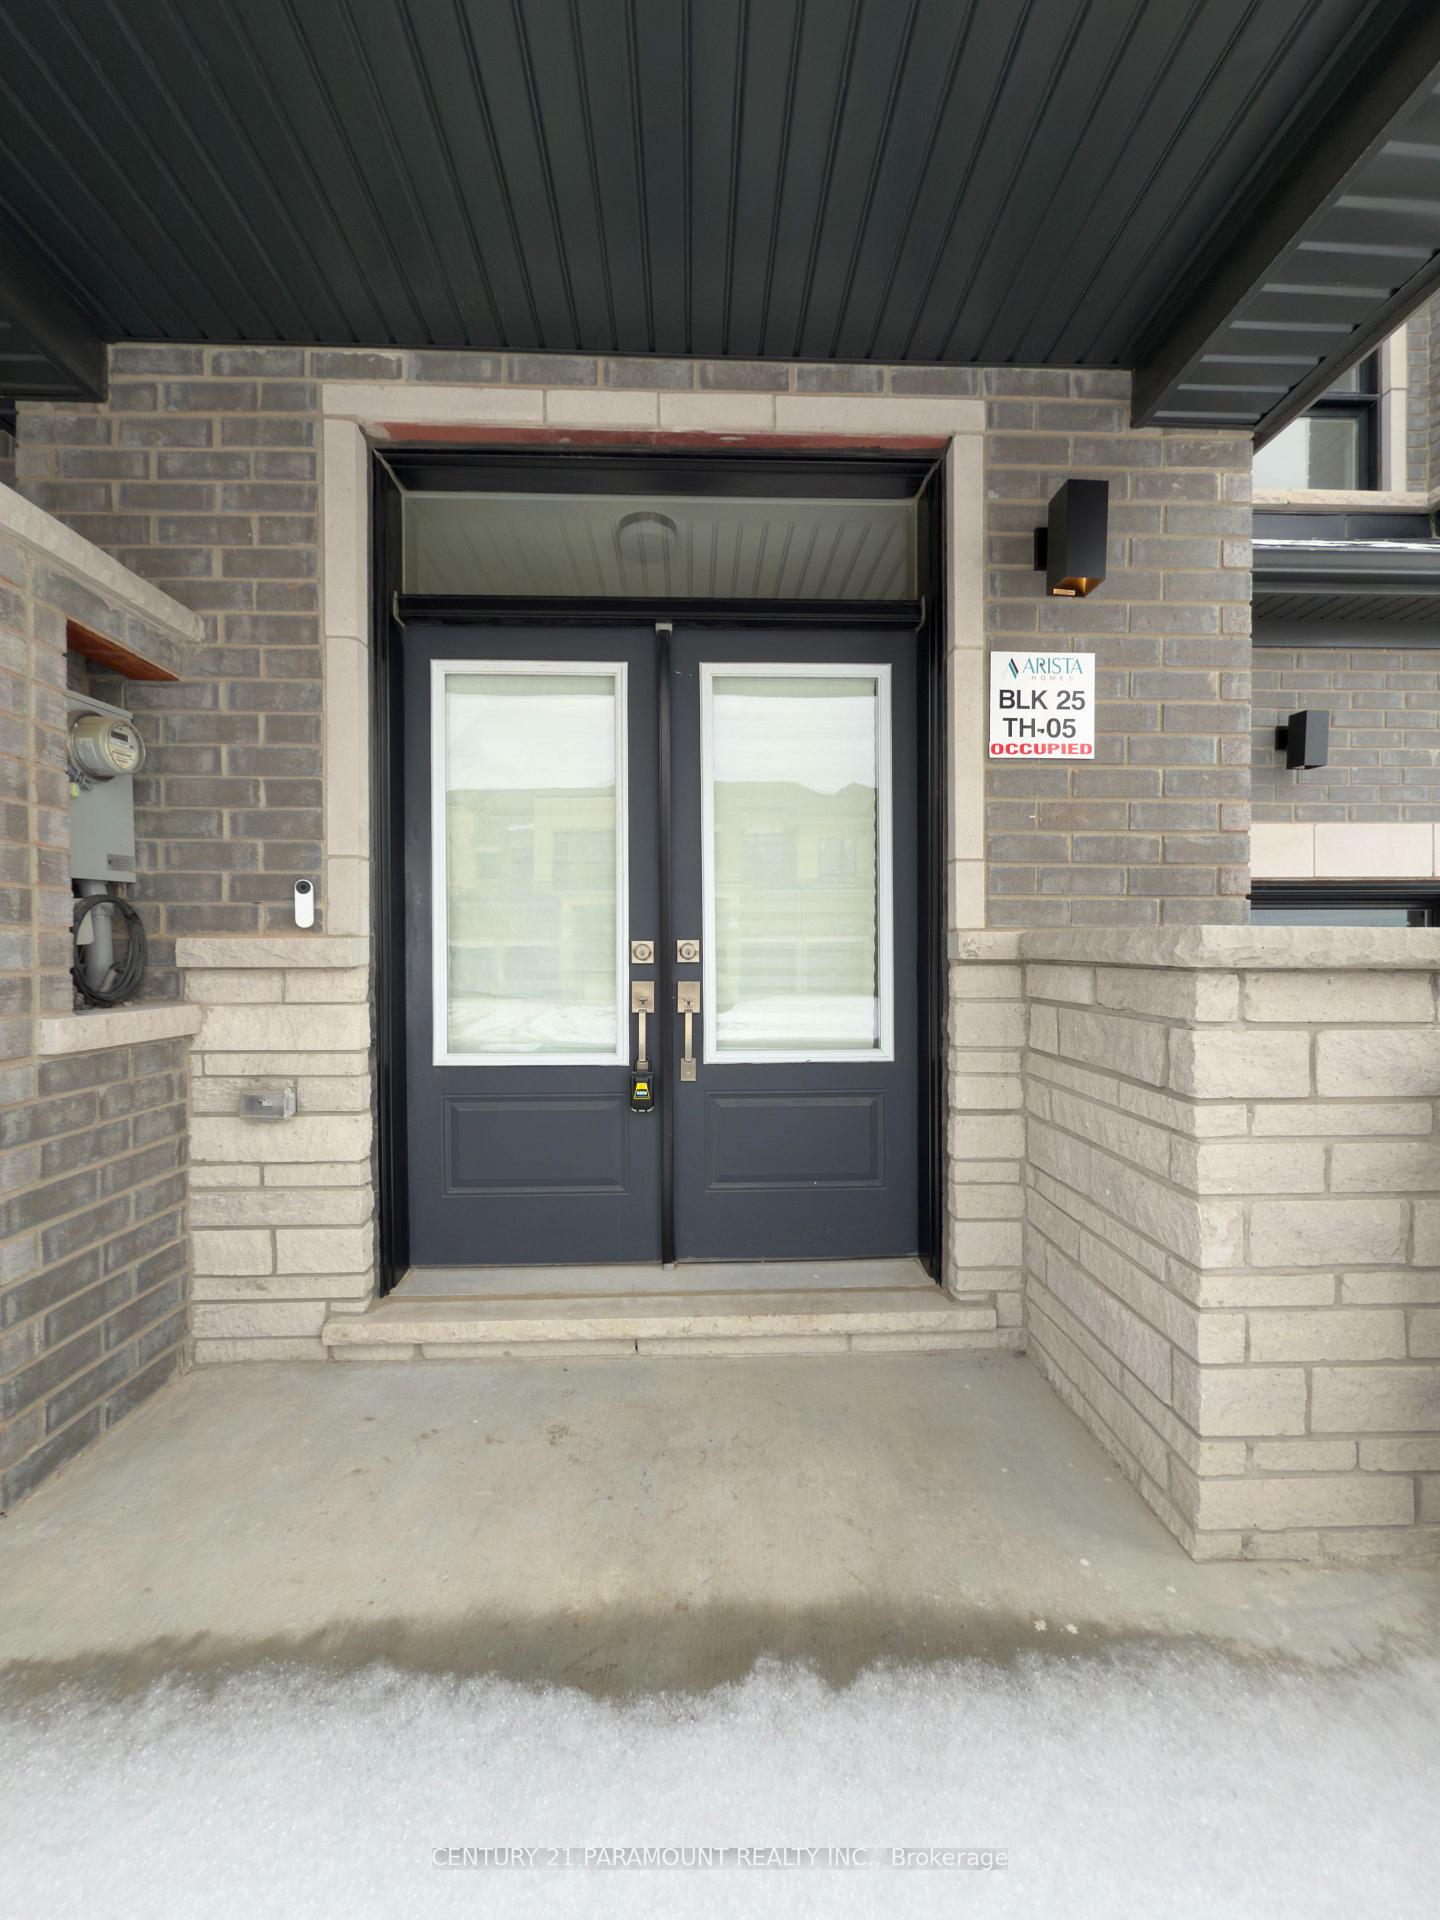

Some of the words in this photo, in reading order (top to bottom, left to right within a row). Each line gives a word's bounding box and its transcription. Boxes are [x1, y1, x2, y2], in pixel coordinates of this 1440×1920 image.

[1023, 657, 1083, 674] ARISTA
[999, 689, 1048, 710] BLK
[1056, 690, 1086, 711] 25
[1002, 717, 1077, 738] TH-05
[990, 743, 1093, 755] OCCUPIED
